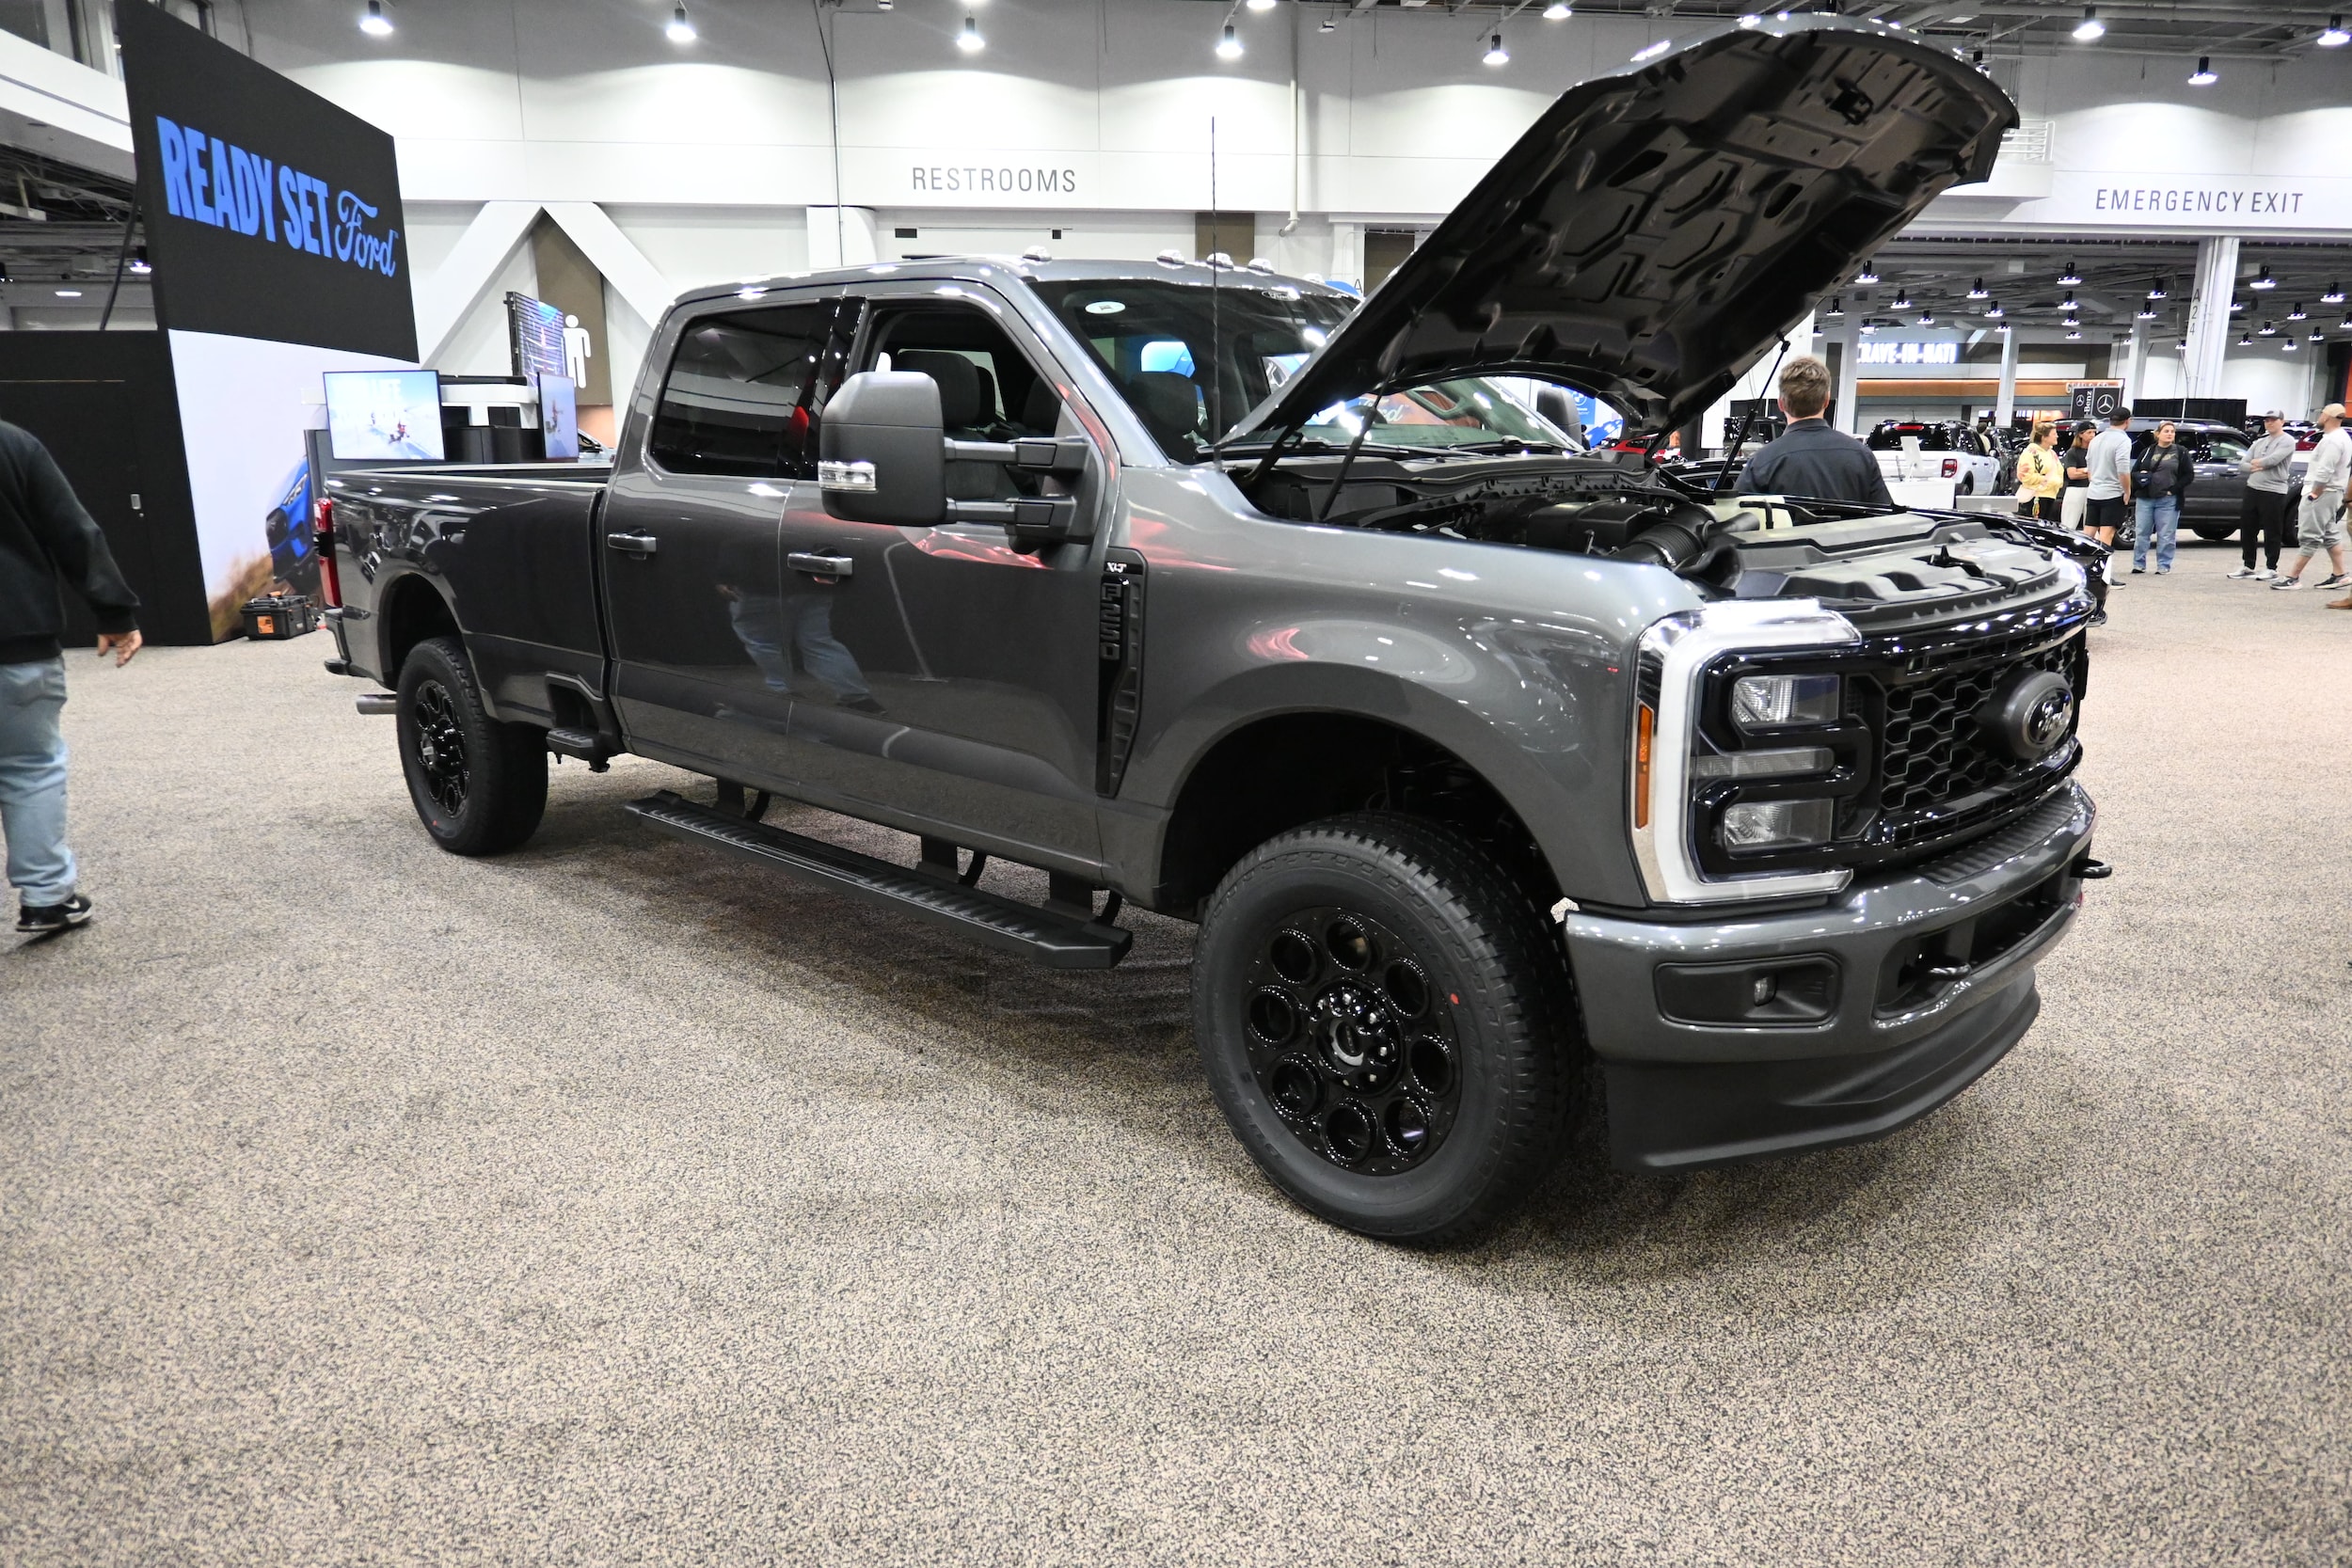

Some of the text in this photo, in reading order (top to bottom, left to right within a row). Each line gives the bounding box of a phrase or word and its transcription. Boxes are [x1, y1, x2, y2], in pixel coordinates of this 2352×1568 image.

[912, 166, 1076, 193] RESTROOMS
[156, 115, 396, 277] READY SET Ford
[2095, 188, 2304, 214] EMERGENCY EXIT
[1106, 562, 1127, 573] XLT
